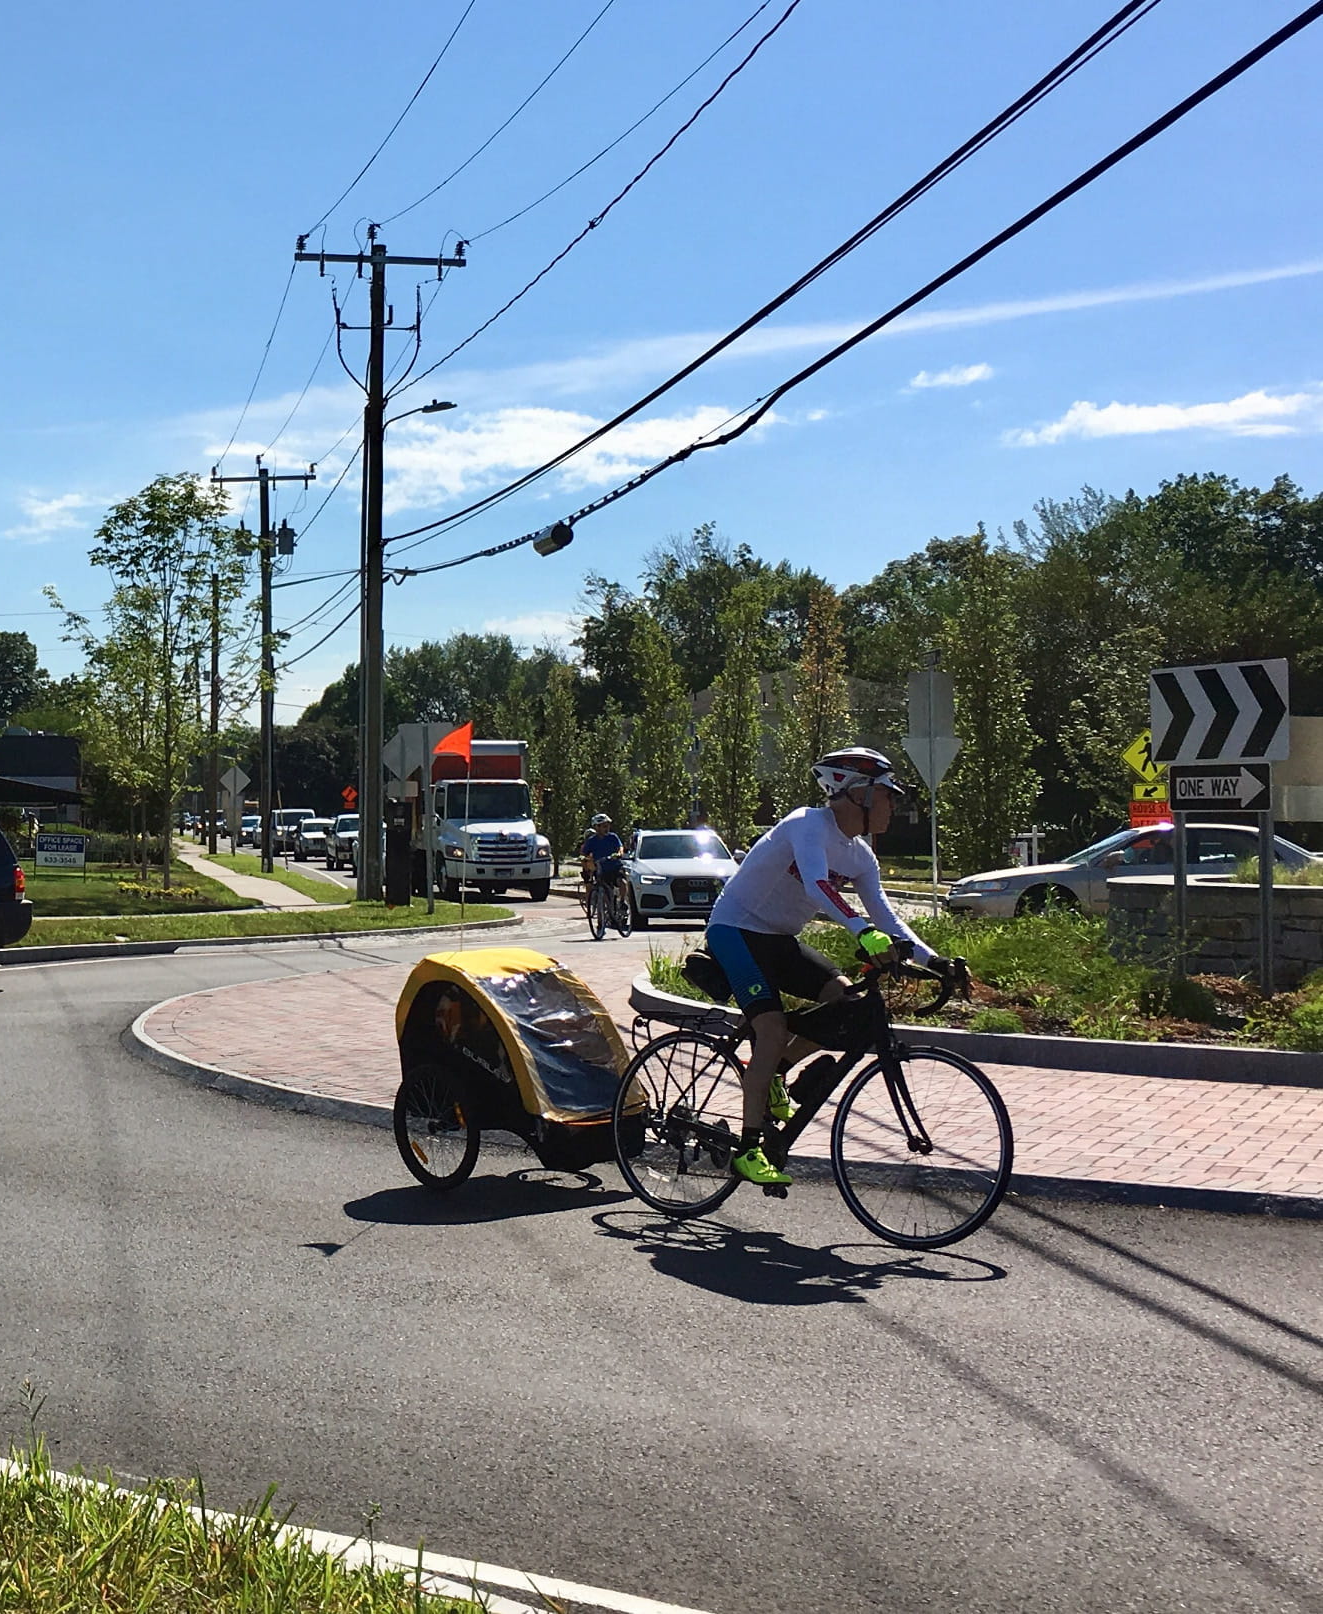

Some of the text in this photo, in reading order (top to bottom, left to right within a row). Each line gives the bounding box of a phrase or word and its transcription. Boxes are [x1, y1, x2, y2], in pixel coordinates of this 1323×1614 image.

[1178, 778, 1239, 797] ONE WAY
[39, 836, 83, 845] OFFICE SPACE
